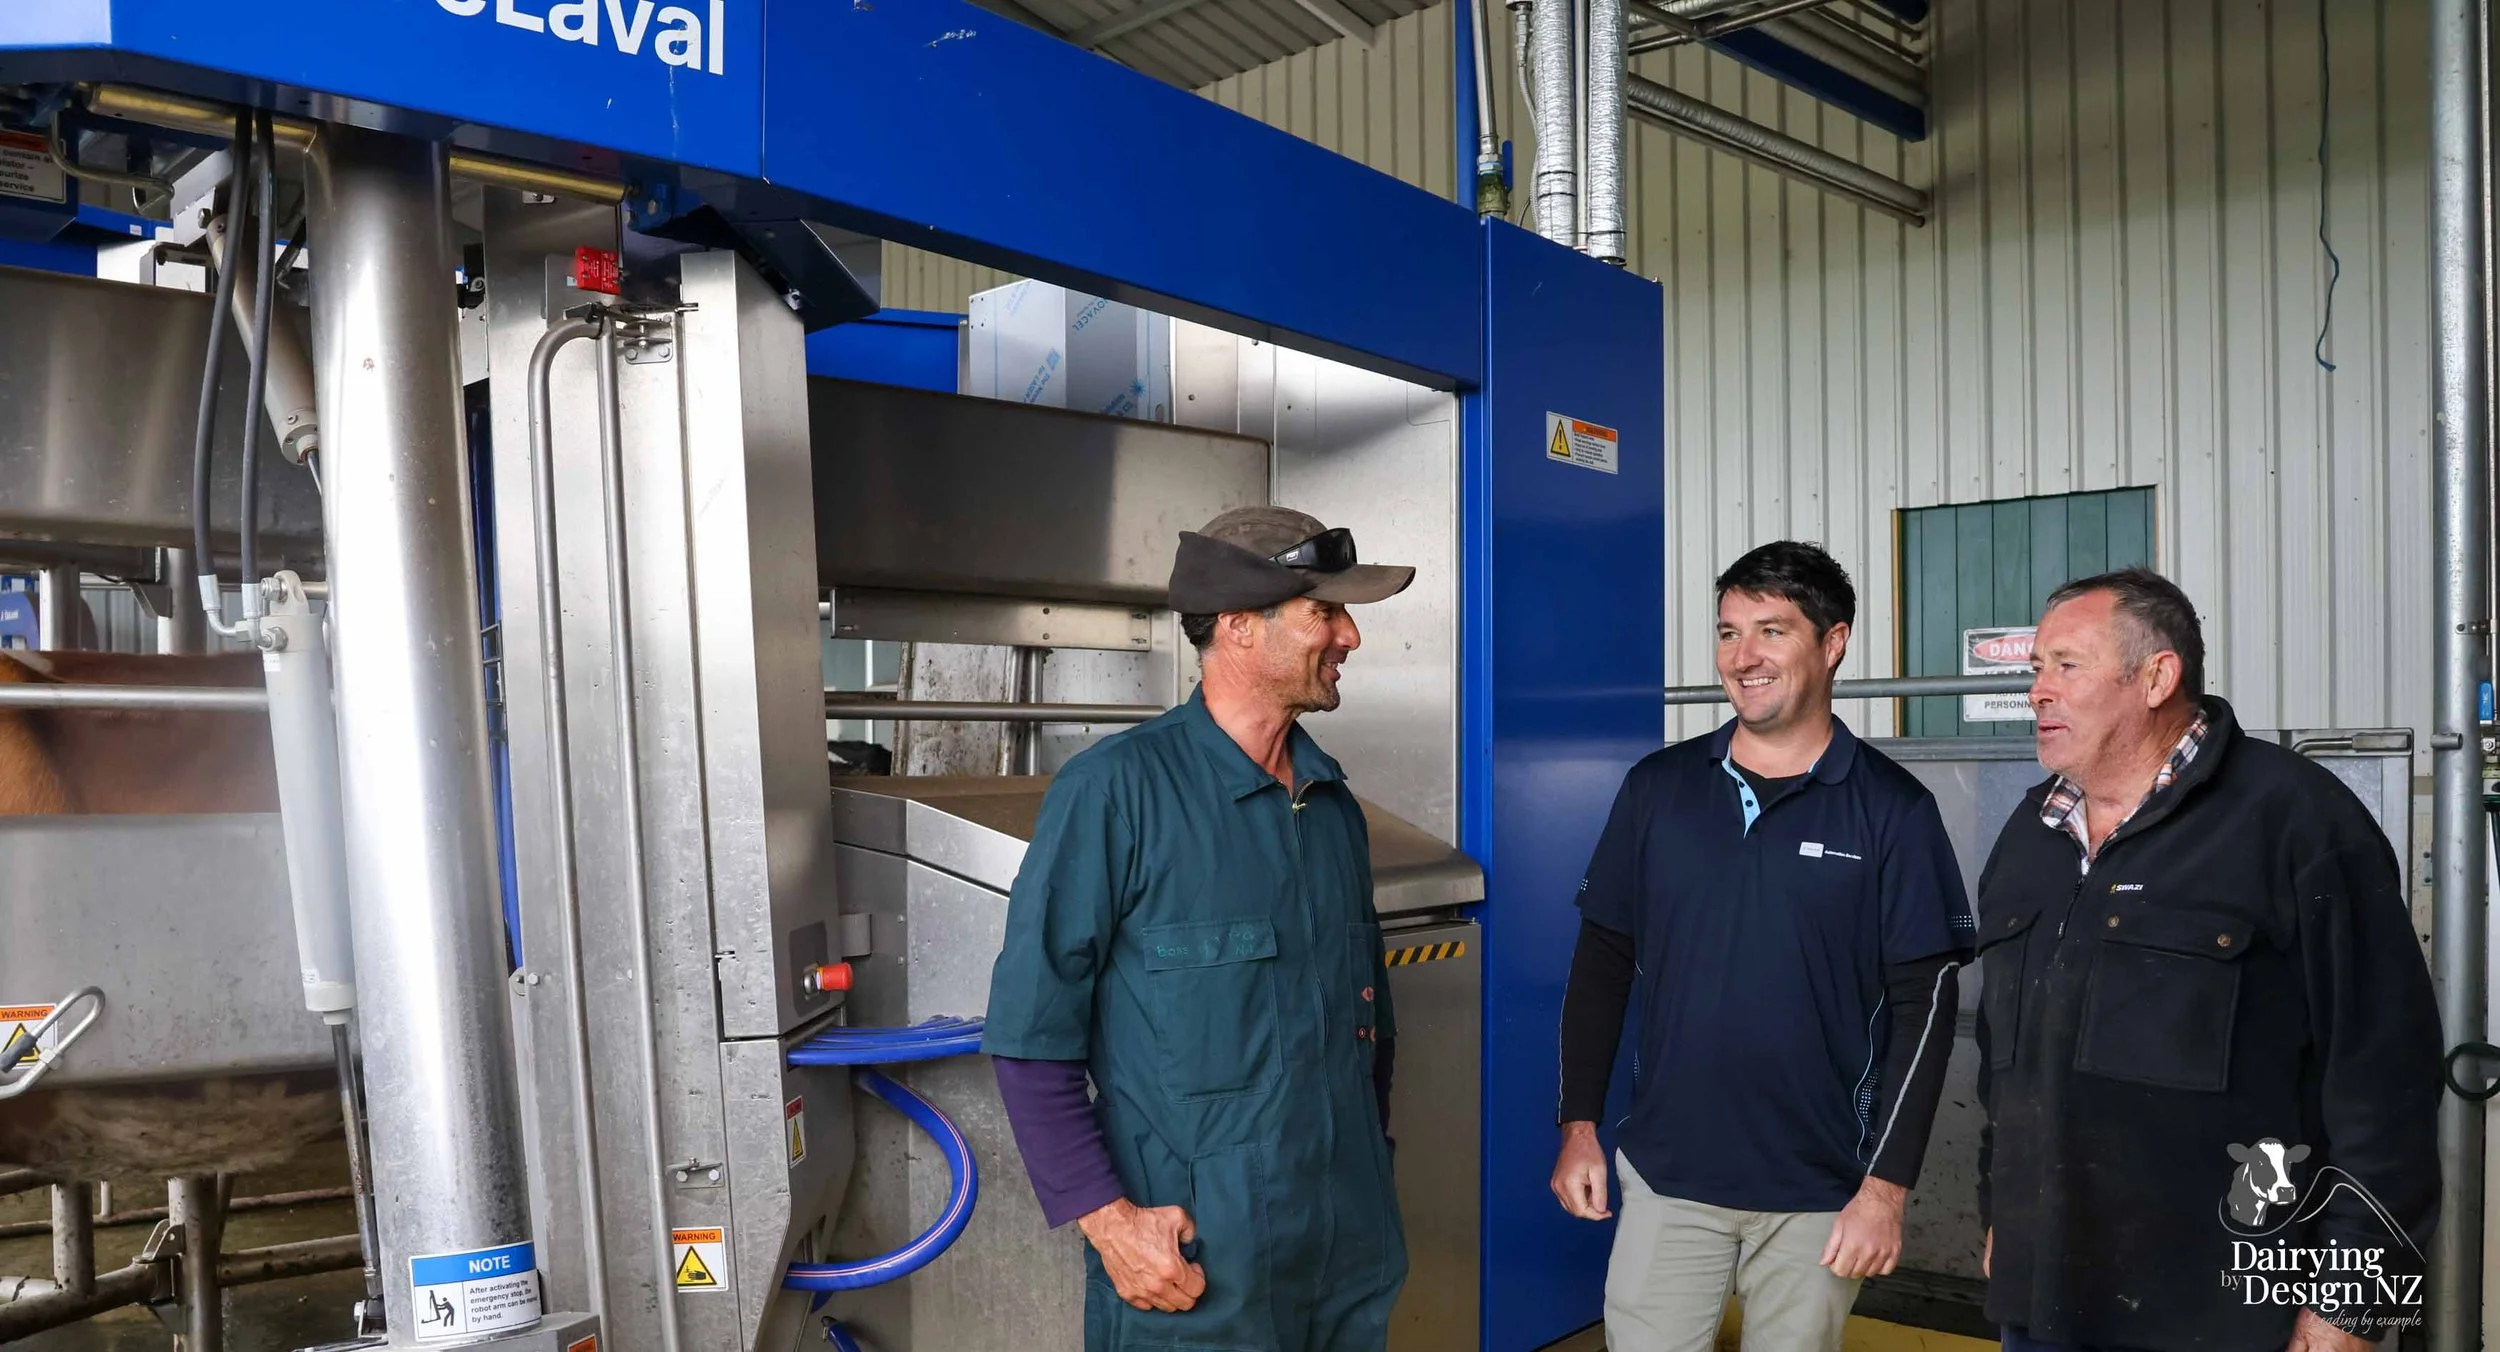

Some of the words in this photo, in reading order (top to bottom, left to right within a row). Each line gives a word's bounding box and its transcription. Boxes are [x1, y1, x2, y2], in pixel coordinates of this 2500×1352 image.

[0, 1009, 48, 1018] WARNING
[672, 1232, 716, 1241] WARNING
[469, 1255, 511, 1274] NOTE
[490, 1281, 520, 1292] activating
[470, 1293, 509, 1304] emergency
[471, 1304, 492, 1313] robot
[493, 1302, 506, 1310] arm
